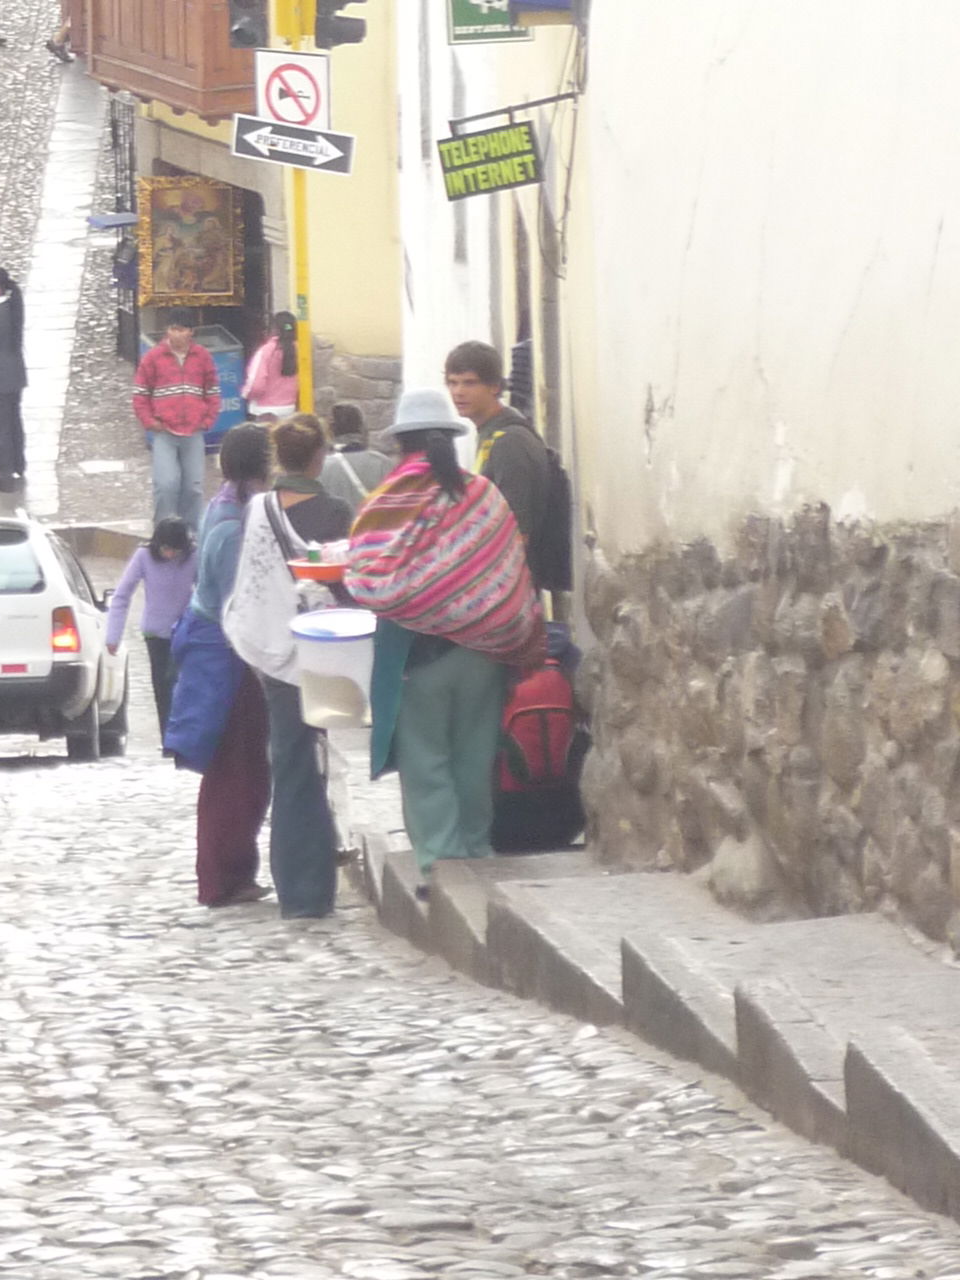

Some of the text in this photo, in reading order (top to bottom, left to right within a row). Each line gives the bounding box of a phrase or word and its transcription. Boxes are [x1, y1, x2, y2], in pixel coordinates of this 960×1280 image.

[255, 134, 331, 157] PREFERENCIAL
[440, 125, 533, 168] TELEPHONE
[445, 153, 536, 196] INTERNET
